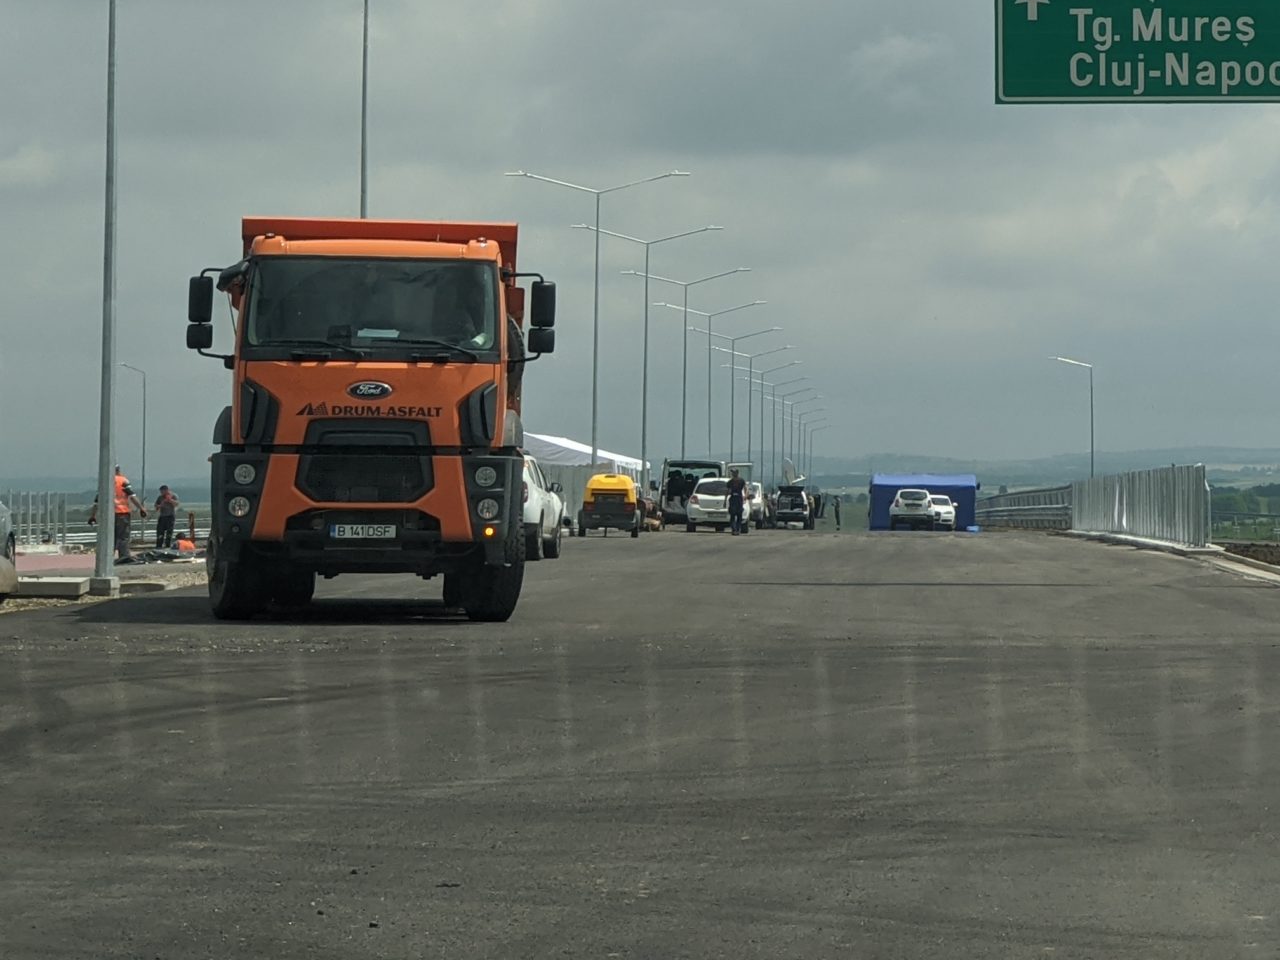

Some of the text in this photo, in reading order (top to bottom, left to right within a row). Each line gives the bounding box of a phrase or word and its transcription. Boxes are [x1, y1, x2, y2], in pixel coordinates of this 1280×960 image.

[1069, 8, 1256, 51] Tg. Mureș
[356, 383, 382, 395] Ford
[331, 405, 443, 418] DRUM-ASFALT
[337, 526, 346, 537] B
[350, 526, 365, 537] 141
[367, 526, 392, 537] DSF
